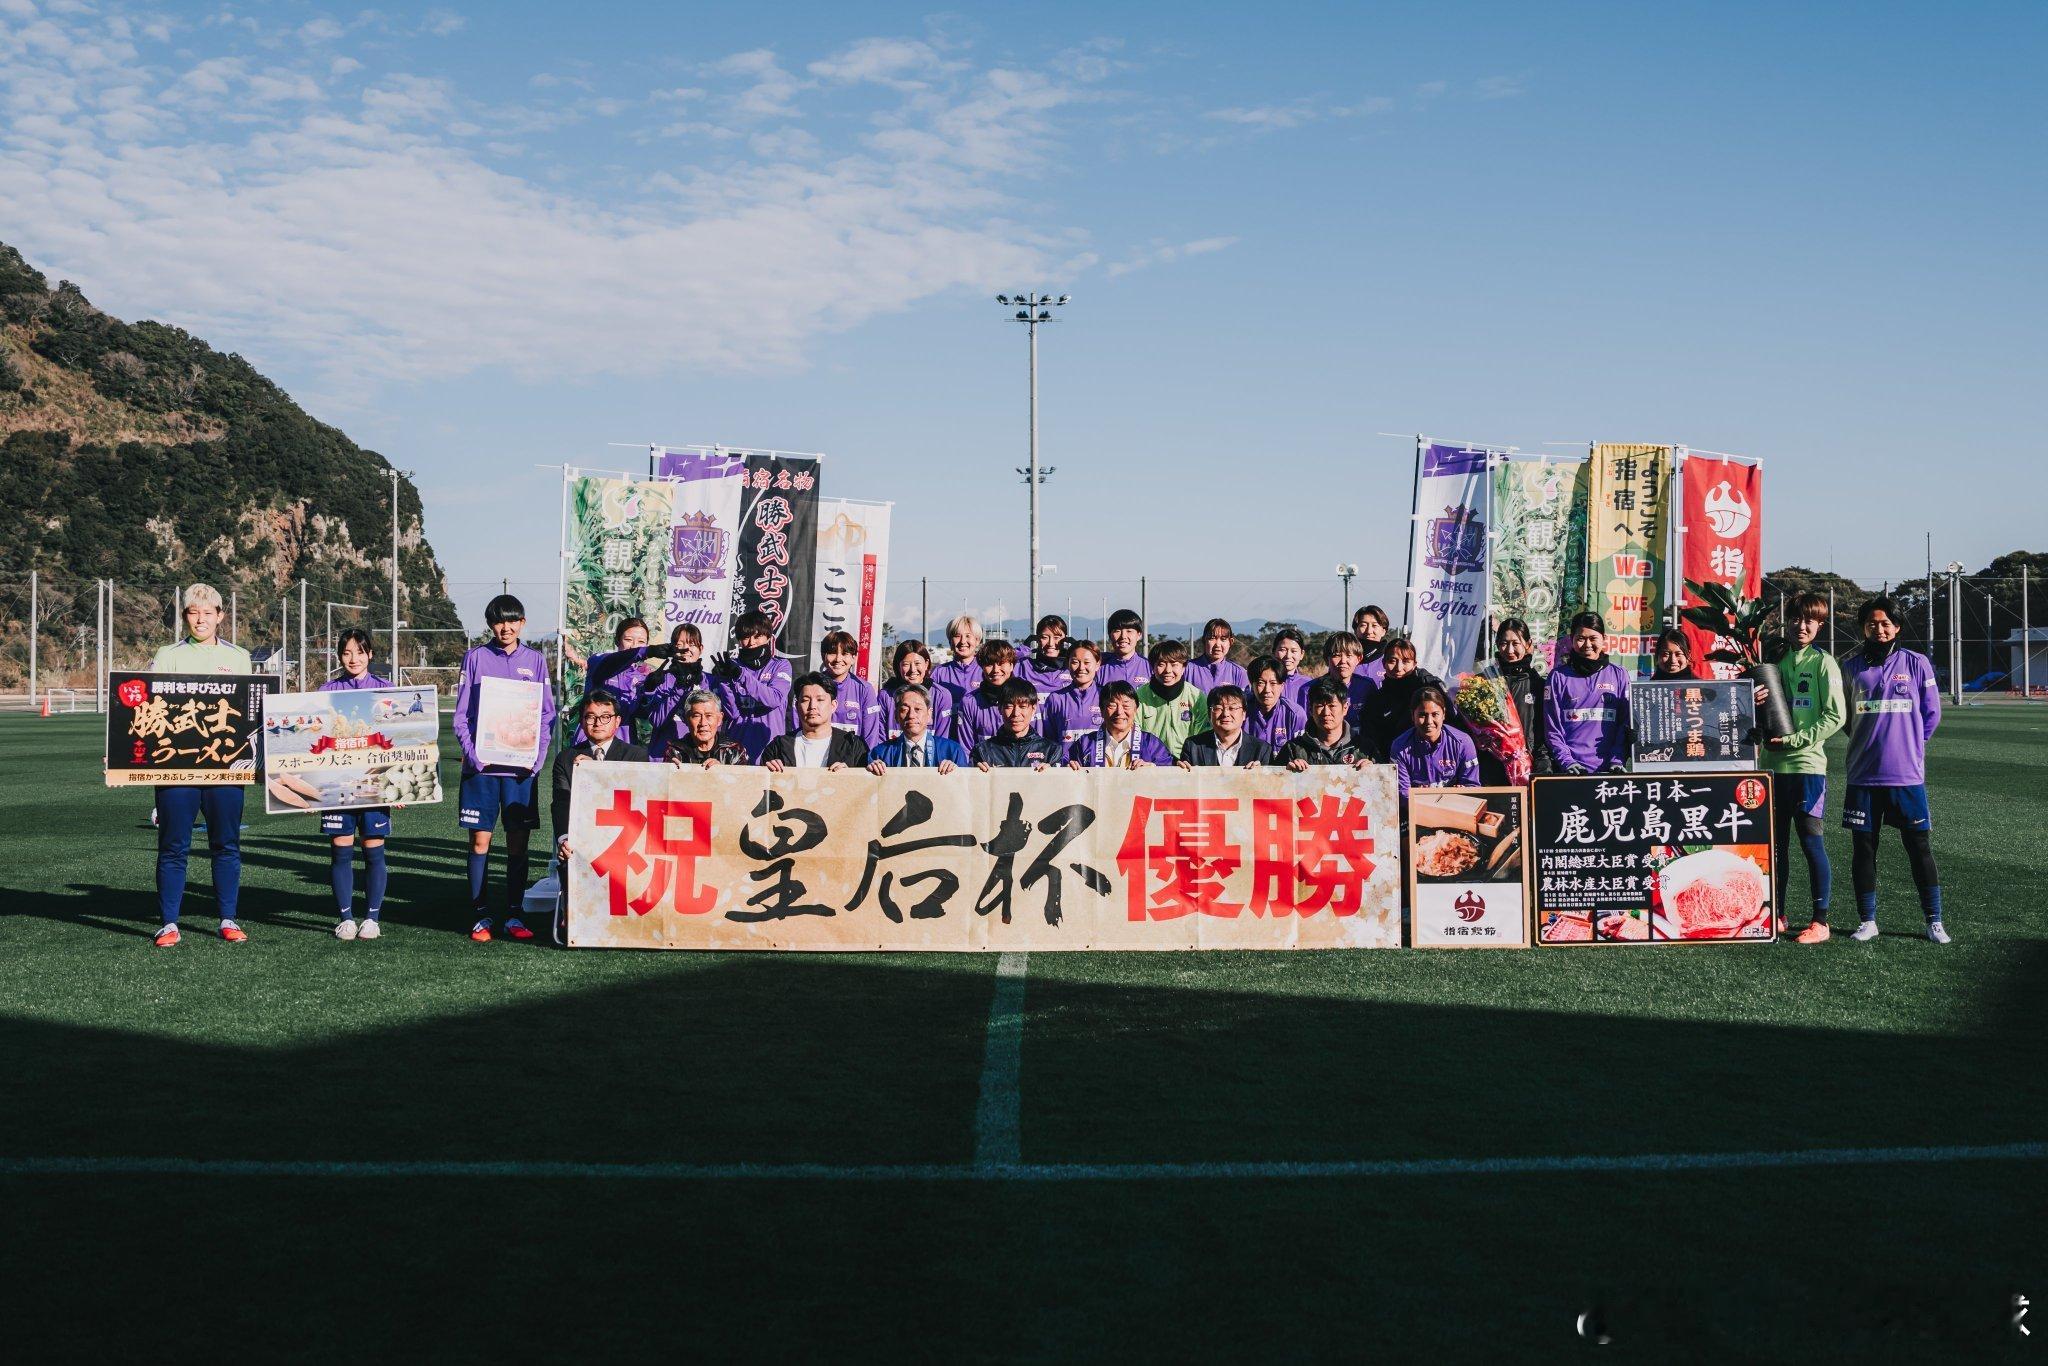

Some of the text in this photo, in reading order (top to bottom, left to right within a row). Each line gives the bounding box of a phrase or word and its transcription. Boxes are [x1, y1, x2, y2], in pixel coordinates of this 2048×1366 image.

[1614, 459, 1637, 537] 指宿へ
[1638, 460, 1659, 539] ようこそ
[755, 496, 793, 657] 勝武士ラ
[1613, 555, 1654, 578] We
[673, 589, 716, 601] SANFRECCE
[1430, 580, 1473, 592] SANFRECCE
[665, 601, 723, 625] Regina
[1419, 591, 1477, 620] Regina
[1613, 595, 1648, 611] LOVE
[151, 681, 237, 695] 勝利を呼び込む!
[128, 695, 242, 738] 勝武士
[1685, 688, 1705, 757] 黒さつま鶏
[151, 737, 249, 764] ラーメン
[335, 737, 368, 749] 指宿市
[1595, 780, 1712, 803] 和牛日本一
[1555, 803, 1753, 843] 鹿児島黒牛
[1541, 854, 1639, 869] 内閣総理大臣賞
[1540, 876, 1640, 891] 農林水産大臣賞
